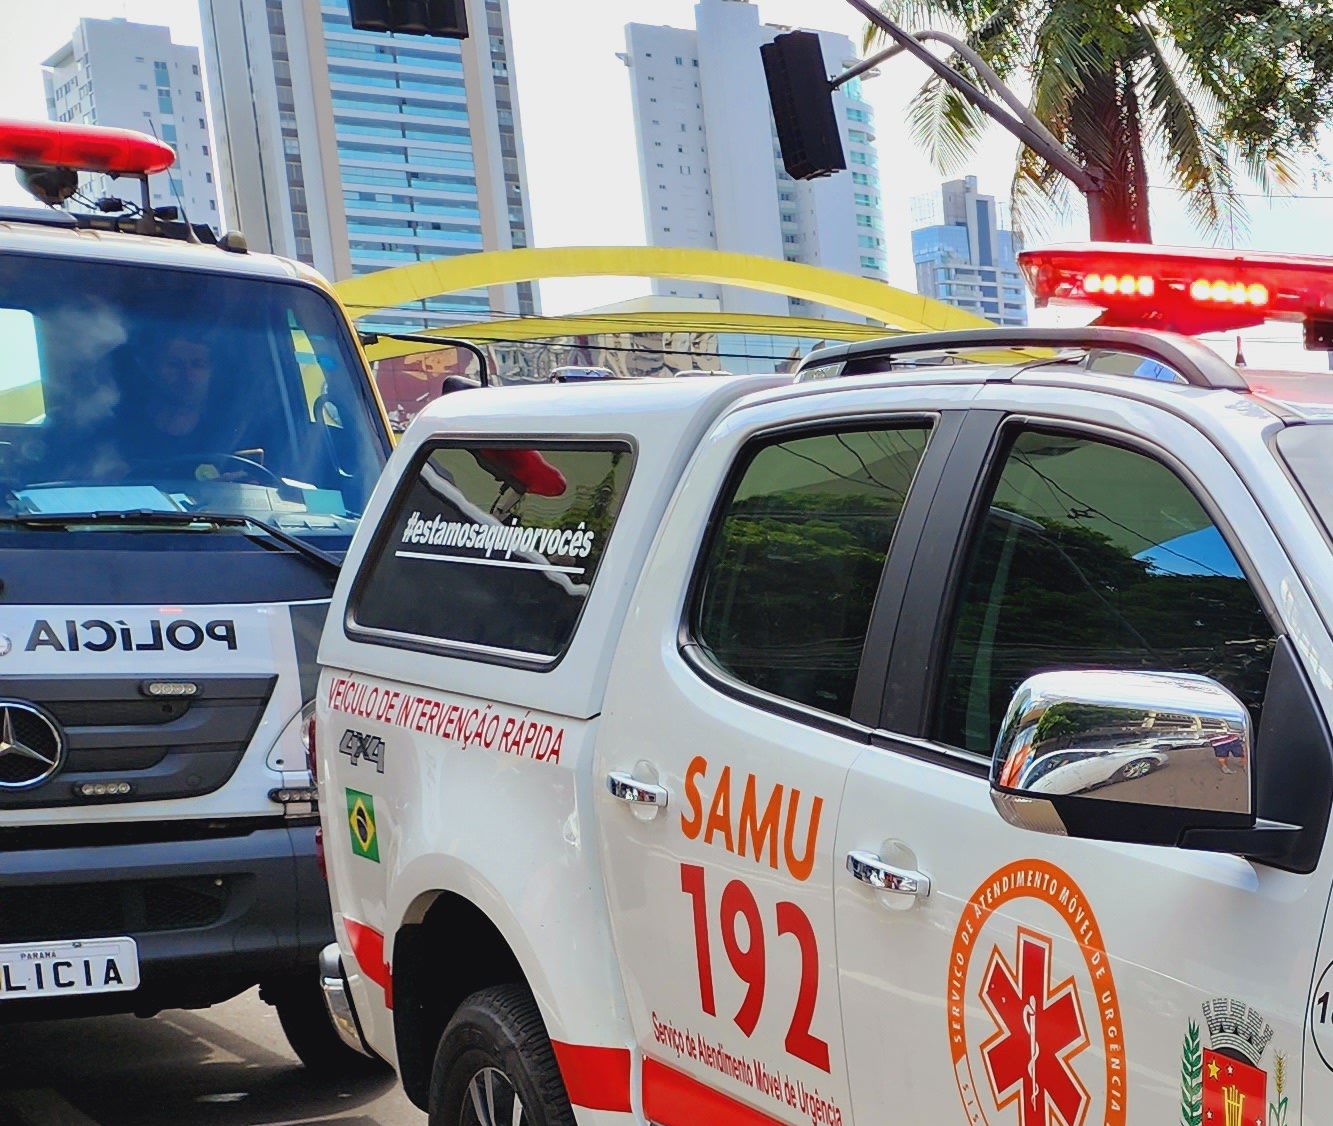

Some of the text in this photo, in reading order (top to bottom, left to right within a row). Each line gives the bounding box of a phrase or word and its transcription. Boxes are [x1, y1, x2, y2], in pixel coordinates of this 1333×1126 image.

[401, 511, 595, 560] #estamosaquiporvocês
[328, 673, 564, 764] VEÍCULO DE INTERVENÇÃO RÁPIDA
[680, 756, 824, 881] SAMU
[0, 958, 123, 992] LICIA
[681, 863, 831, 1074] 192
[951, 870, 1122, 1112] SERVIÇO DE ATENDIMENTO MÓVEL DE URGÊNCIA
[651, 1011, 685, 1059] Serviço
[686, 1028, 698, 1060] de
[697, 1033, 754, 1088] Atendimento
[753, 1058, 784, 1102] Móvel
[784, 1074, 798, 1109] de
